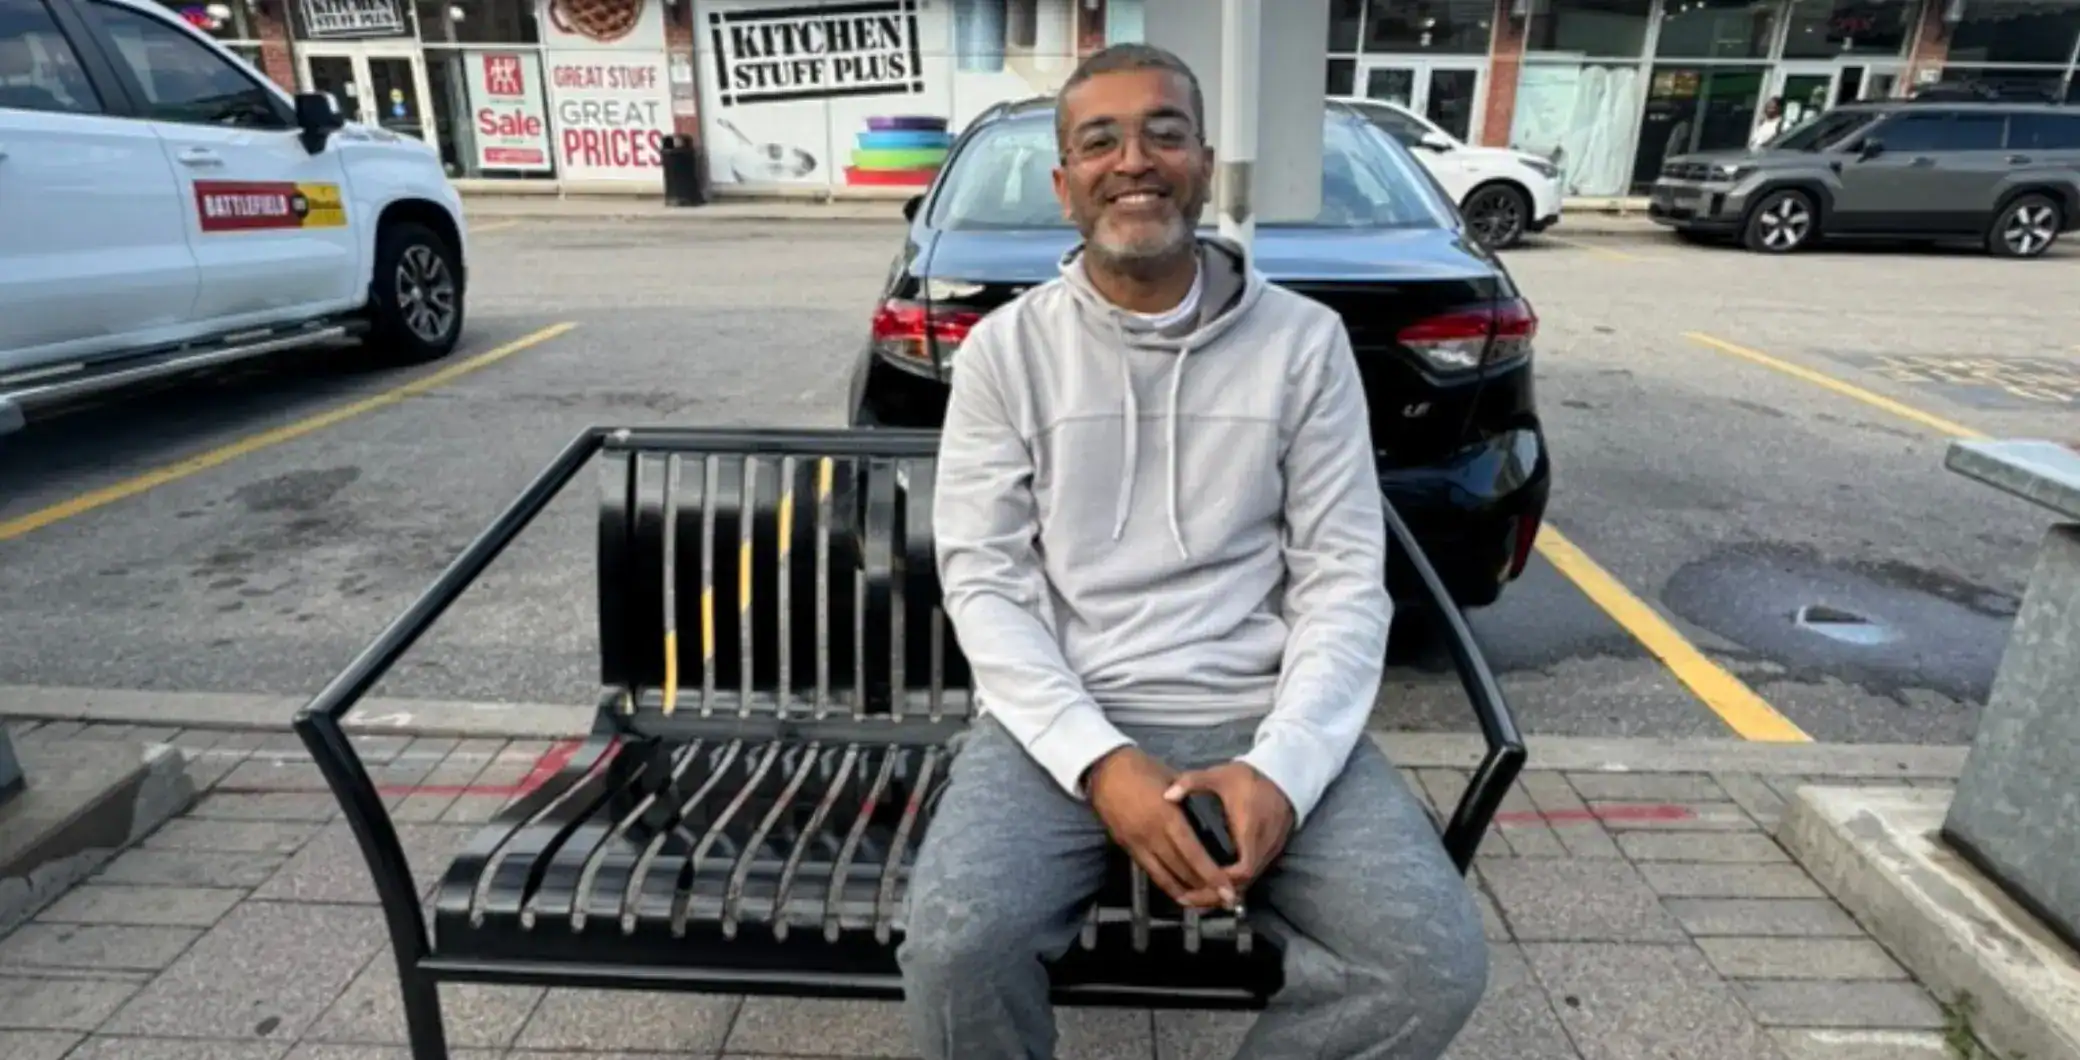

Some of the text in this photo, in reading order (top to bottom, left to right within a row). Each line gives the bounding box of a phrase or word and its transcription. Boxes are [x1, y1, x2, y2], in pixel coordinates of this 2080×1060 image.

[731, 15, 901, 59] KITCHEN
[554, 65, 657, 89] GREAT STUFF
[734, 52, 905, 89] STUFF PLUS
[478, 107, 541, 136] Sale
[559, 99, 660, 125] GREAT
[563, 128, 664, 167] PRICES
[203, 193, 288, 218] BATTLEFIELD
